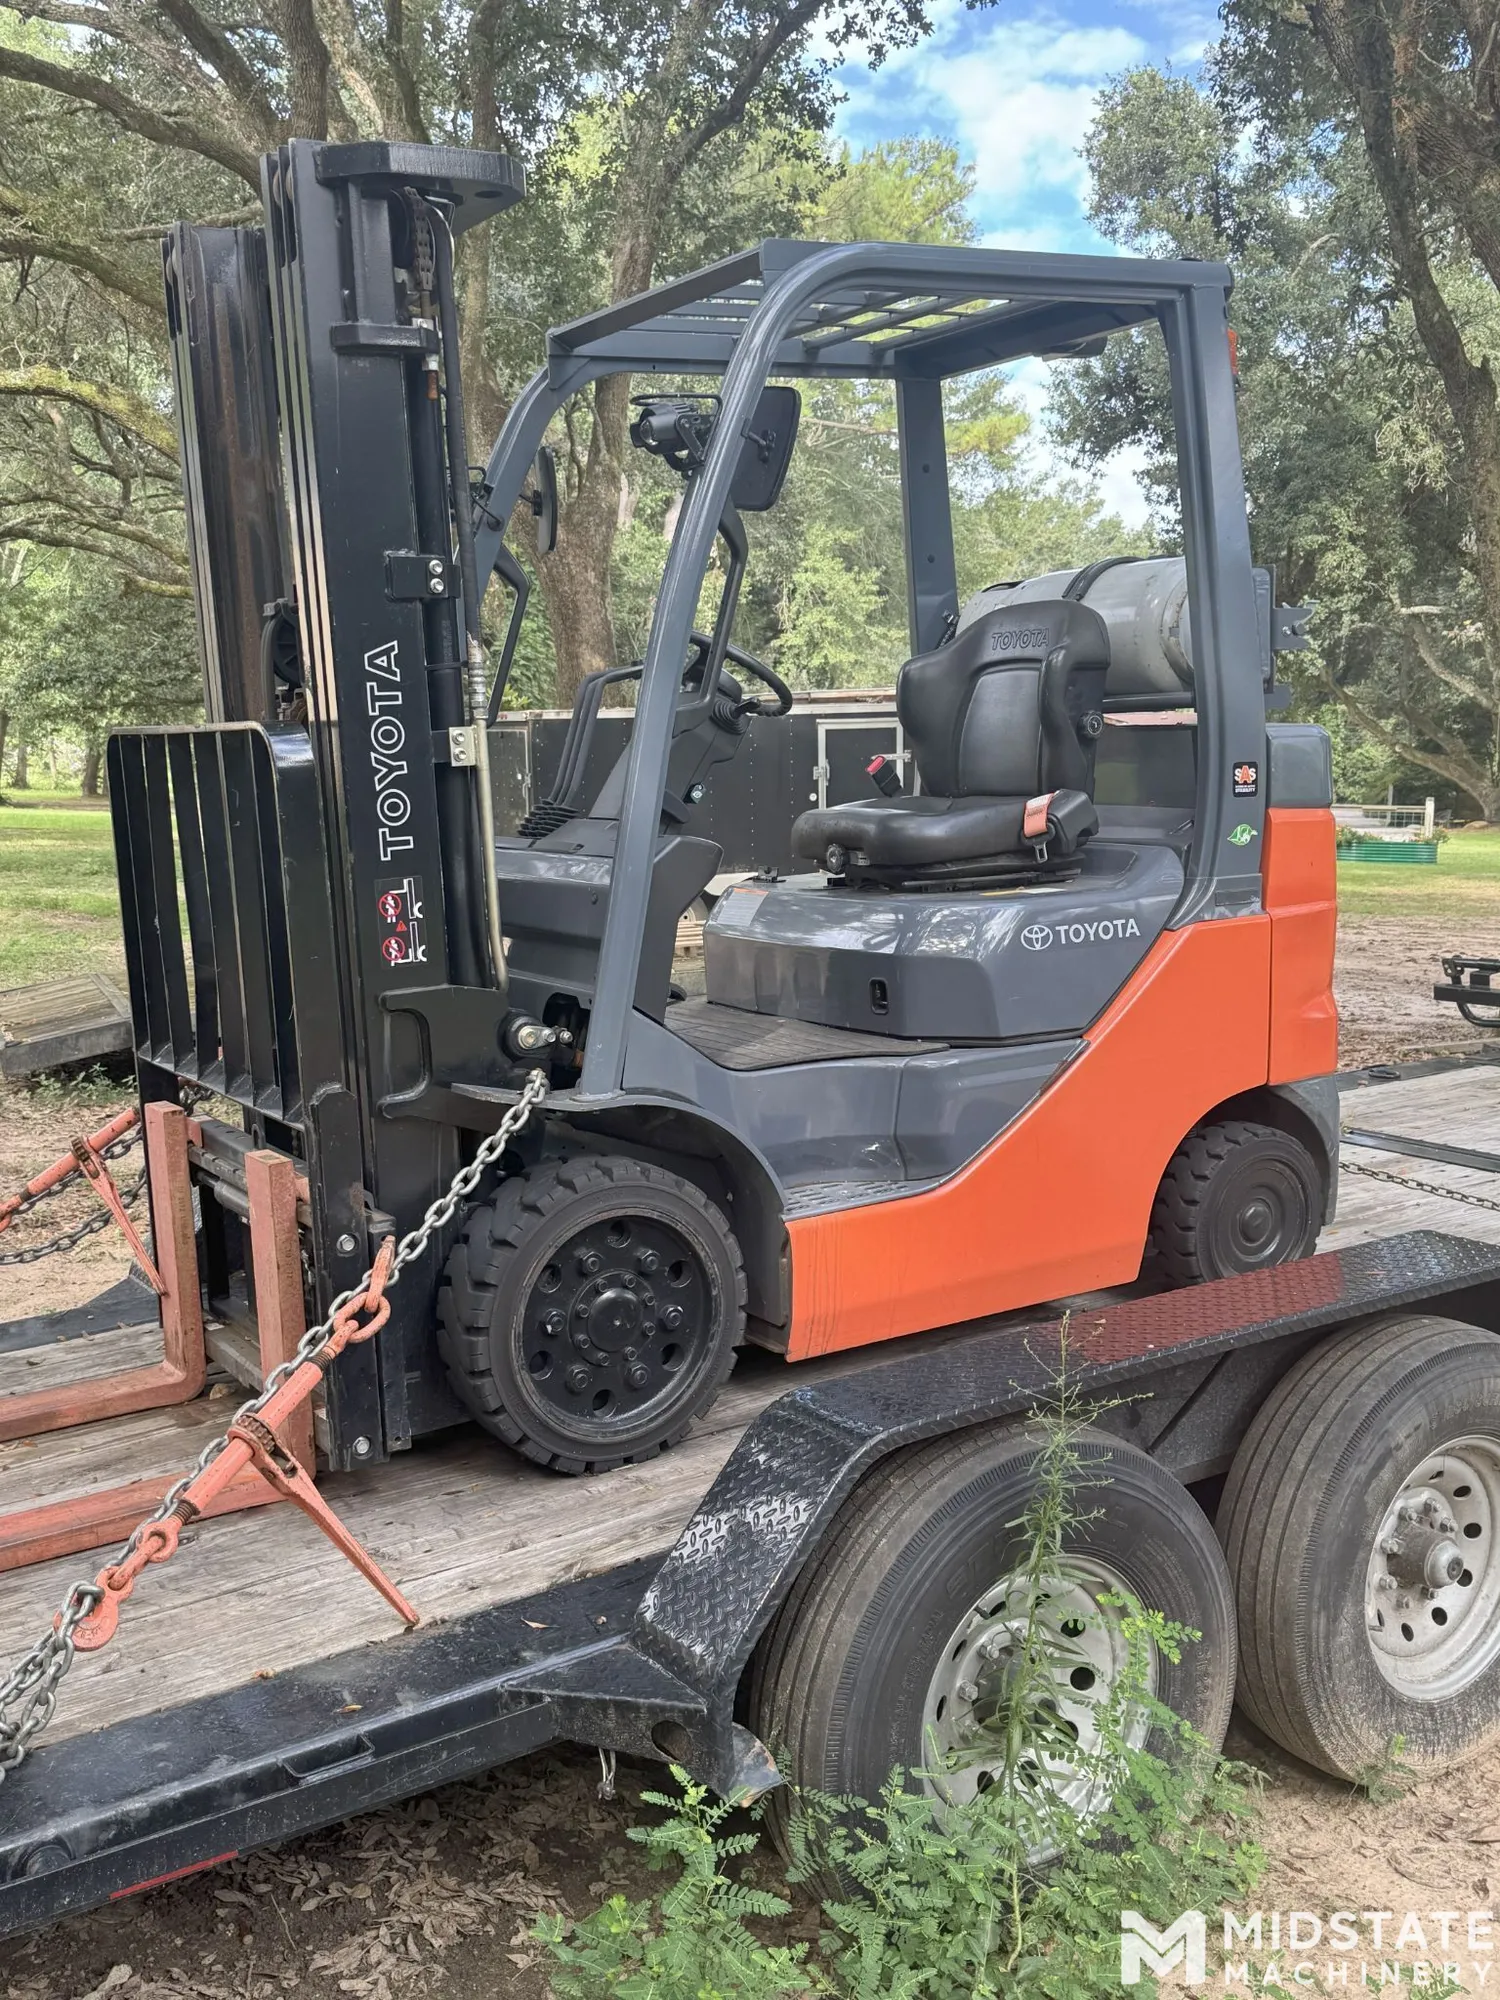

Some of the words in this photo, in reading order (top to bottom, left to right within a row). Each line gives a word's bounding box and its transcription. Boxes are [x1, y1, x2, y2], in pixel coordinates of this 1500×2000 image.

[992, 628, 1049, 651] TOYOTA
[364, 640, 414, 862] TOYOTA
[1234, 765, 1257, 784] SAS
[1055, 918, 1141, 945] TOYOTA
